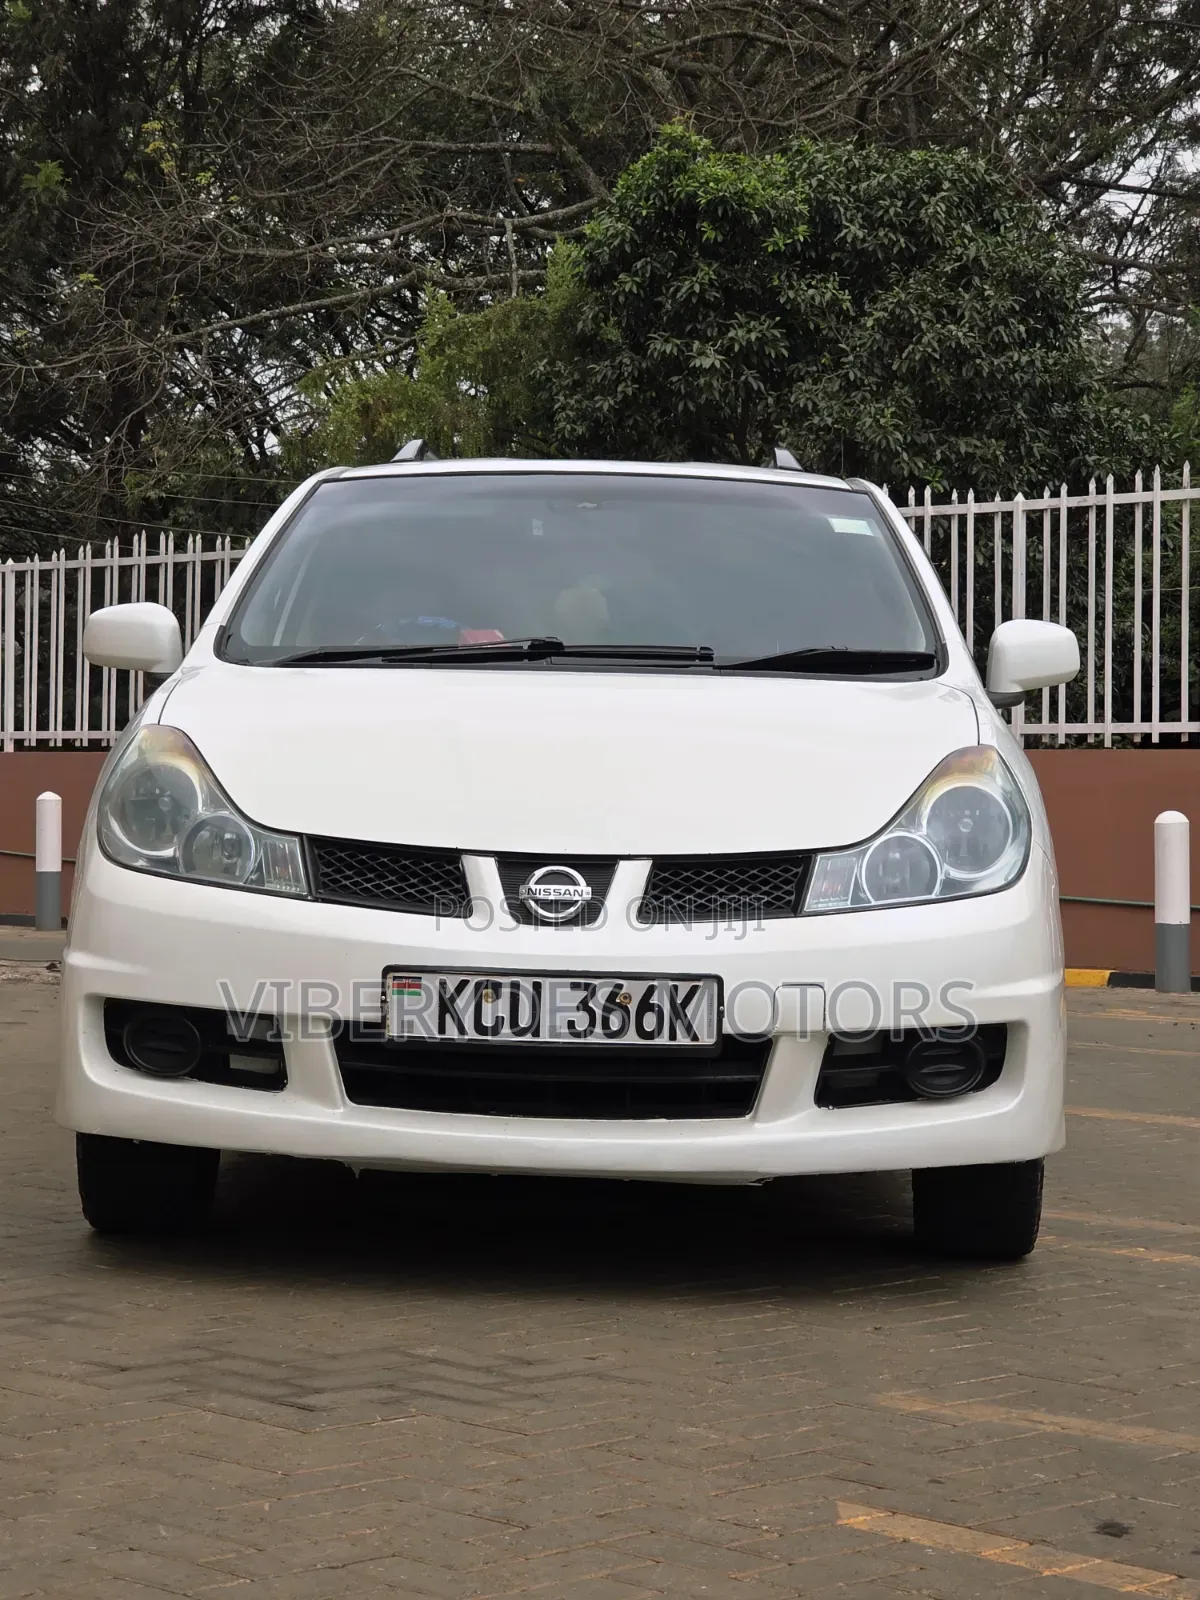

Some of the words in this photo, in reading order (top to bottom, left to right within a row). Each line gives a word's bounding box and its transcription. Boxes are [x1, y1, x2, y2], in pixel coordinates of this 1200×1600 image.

[527, 887, 584, 898] NISSAN
[437, 978, 543, 1038] KCU
[566, 980, 701, 1042] 366K
